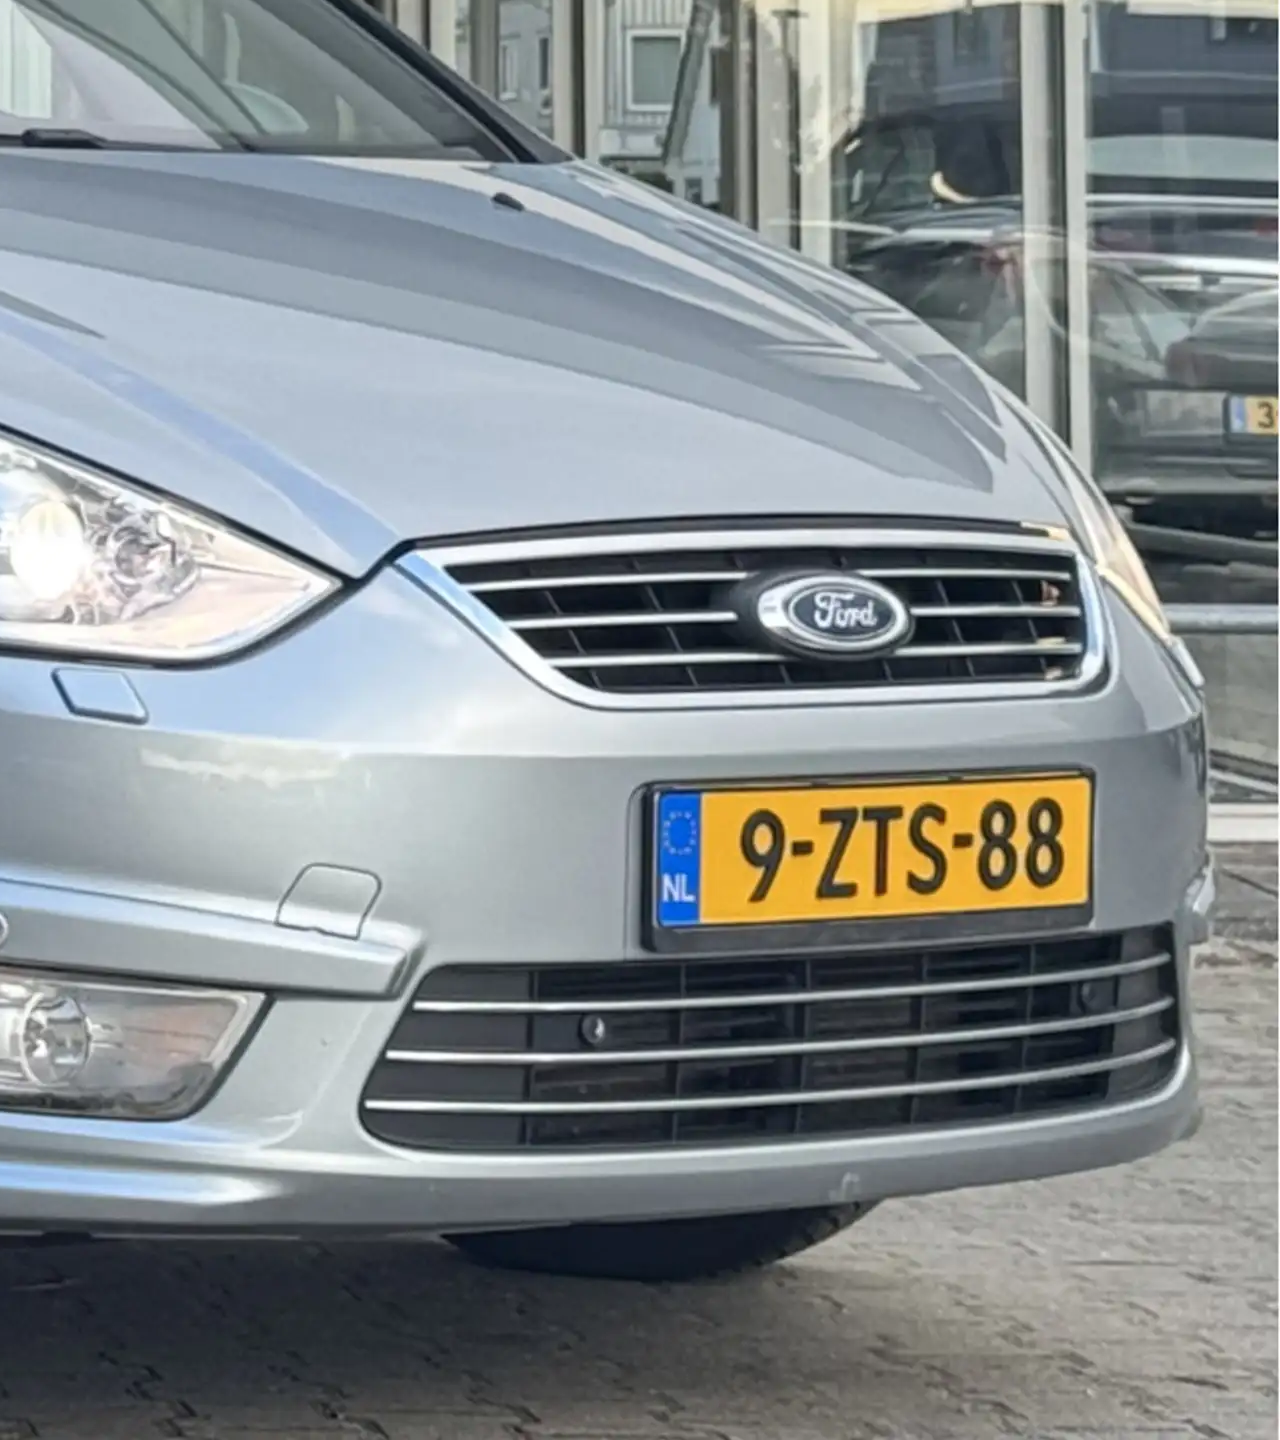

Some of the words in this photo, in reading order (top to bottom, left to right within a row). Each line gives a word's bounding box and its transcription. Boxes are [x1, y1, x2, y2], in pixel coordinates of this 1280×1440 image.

[813, 591, 877, 629] Ford
[739, 797, 1066, 903] 9-ZTS-88
[662, 873, 695, 902] NL
